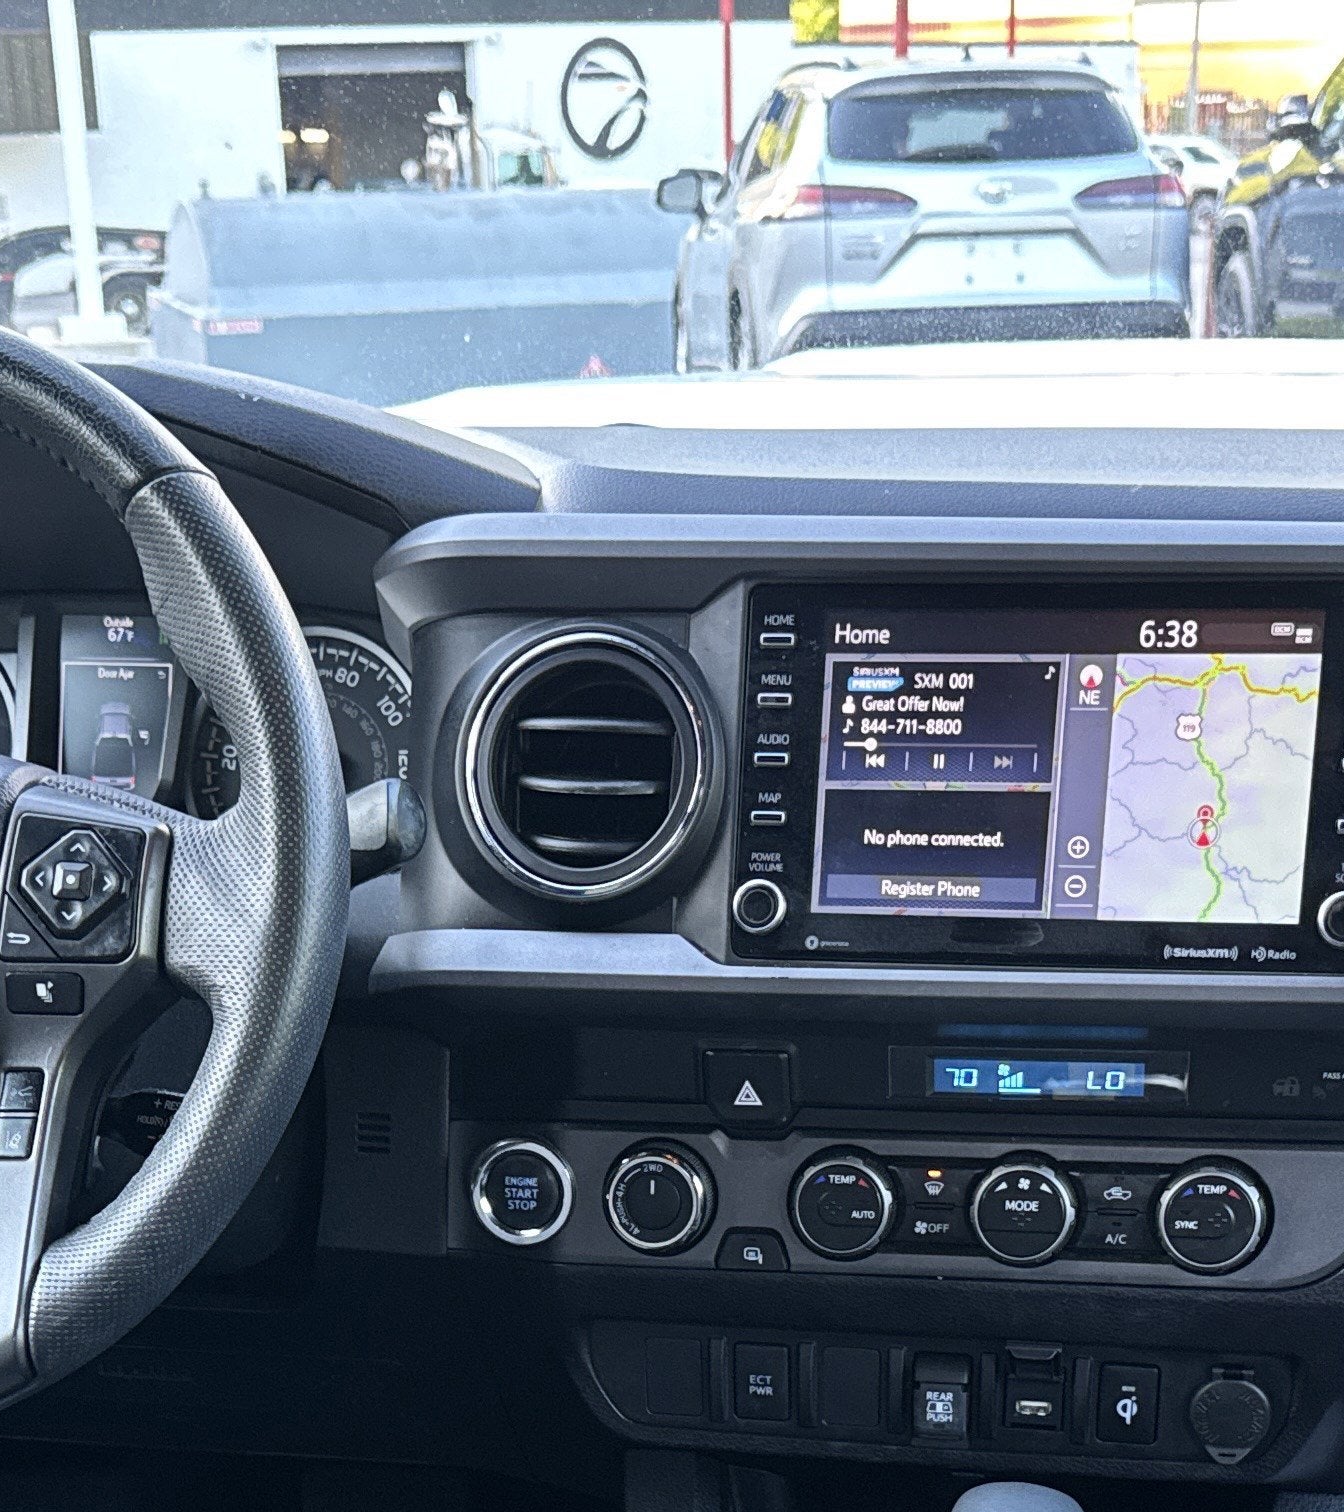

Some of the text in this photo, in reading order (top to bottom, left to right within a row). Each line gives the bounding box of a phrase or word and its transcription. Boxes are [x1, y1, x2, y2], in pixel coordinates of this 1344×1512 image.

[763, 614, 795, 626] HOME
[834, 623, 891, 645] Home
[1139, 620, 1198, 649] 6:38
[334, 667, 360, 688] 80
[761, 674, 793, 686] MENU
[913, 673, 974, 689] SXM 001
[1078, 690, 1100, 705] NE
[862, 696, 965, 712] Great Offer Now!
[376, 694, 404, 727] 100
[860, 718, 962, 735] 844-711-8800
[757, 734, 790, 745] AUDIO
[221, 744, 237, 771] 20
[758, 792, 781, 804] MAP
[863, 828, 1005, 848] No phone connected.
[751, 852, 781, 862] POWER
[749, 862, 783, 873] VOLUME
[881, 879, 980, 898] Register Phone
[1267, 949, 1297, 960] Radio
[945, 1067, 978, 1087] 70
[642, 1163, 664, 1173] 2WD
[505, 1176, 539, 1187] ENGINE
[828, 1174, 856, 1185] TEMP
[505, 1188, 539, 1199] START
[1197, 1184, 1228, 1195] TEMP
[507, 1200, 537, 1211] STOP
[1004, 1200, 1040, 1212] MODE
[850, 1210, 876, 1220] AUTO
[927, 1223, 950, 1234] OFF
[1174, 1220, 1199, 1230] SYNC
[1105, 1233, 1127, 1245] A/C
[749, 1374, 772, 1385] ECT
[749, 1385, 774, 1396] PWR
[926, 1391, 954, 1402] REAR
[926, 1412, 953, 1423] PUSH
